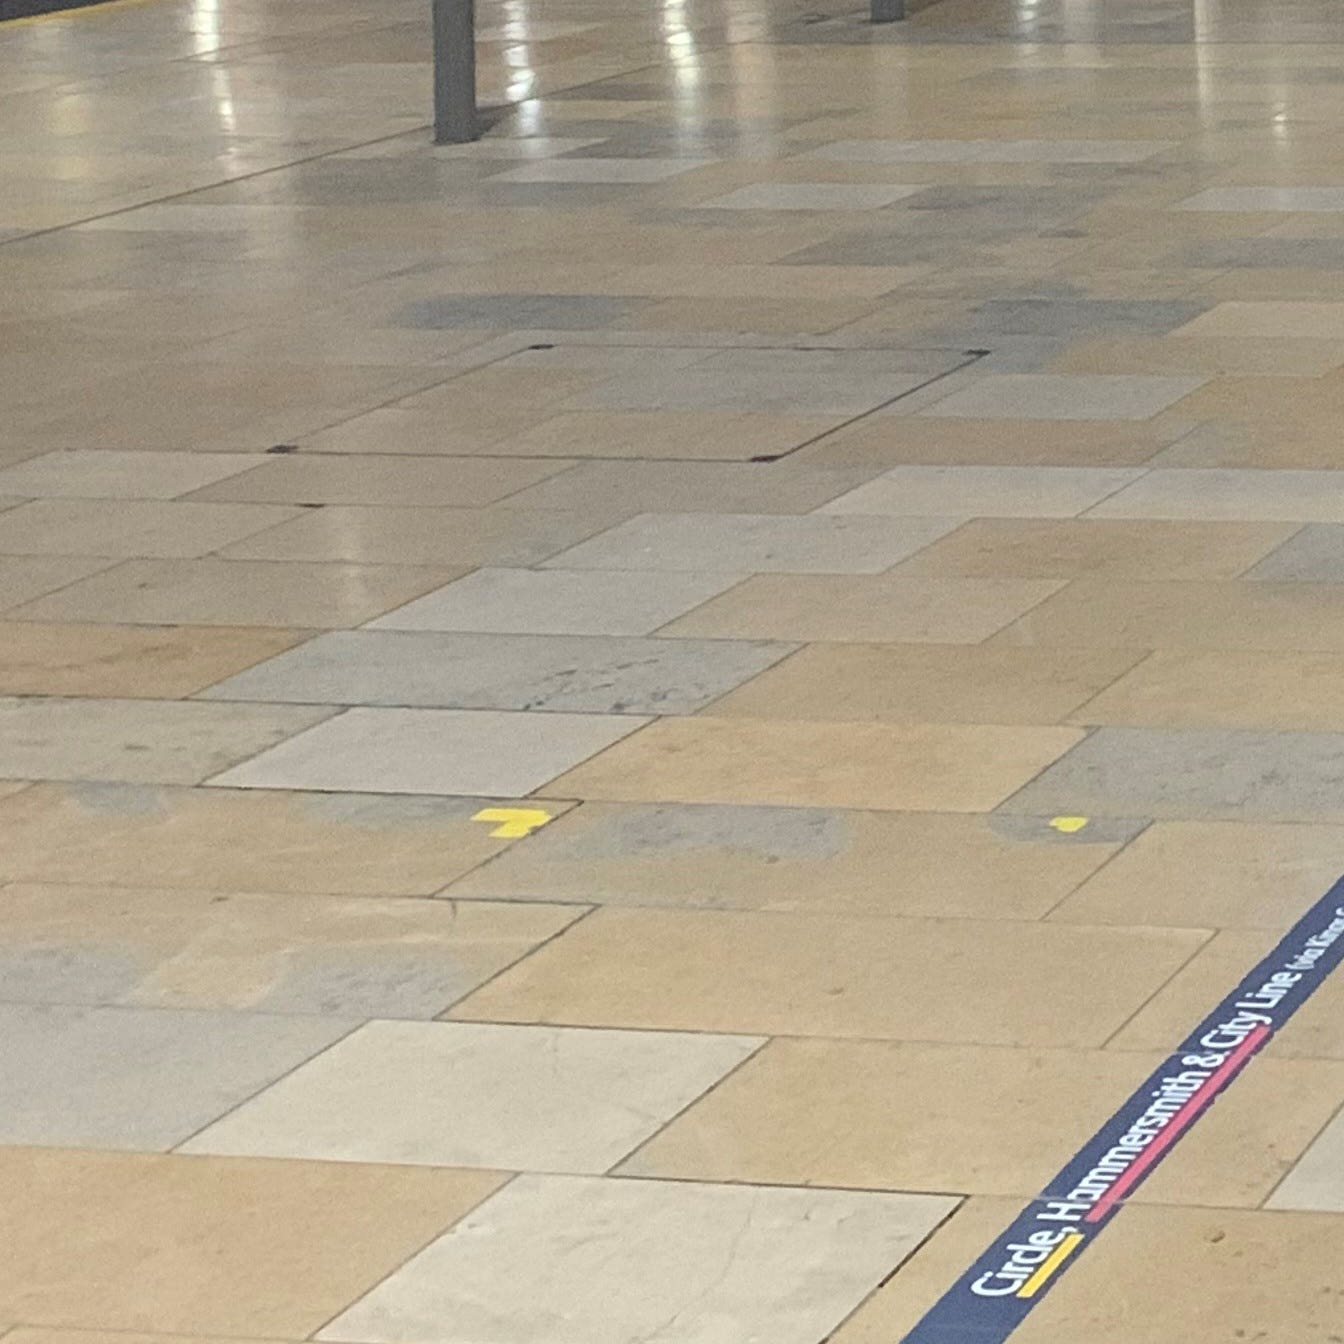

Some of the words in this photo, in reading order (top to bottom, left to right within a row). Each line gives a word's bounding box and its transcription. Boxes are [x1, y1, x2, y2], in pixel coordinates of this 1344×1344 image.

[1284, 946, 1327, 970] (via
[1235, 971, 1302, 1009] Line
[1200, 1011, 1273, 1048] City
[1181, 1050, 1232, 1068] &
[1036, 1070, 1213, 1221] Hammersmith
[970, 1226, 1080, 1296] Circle,
